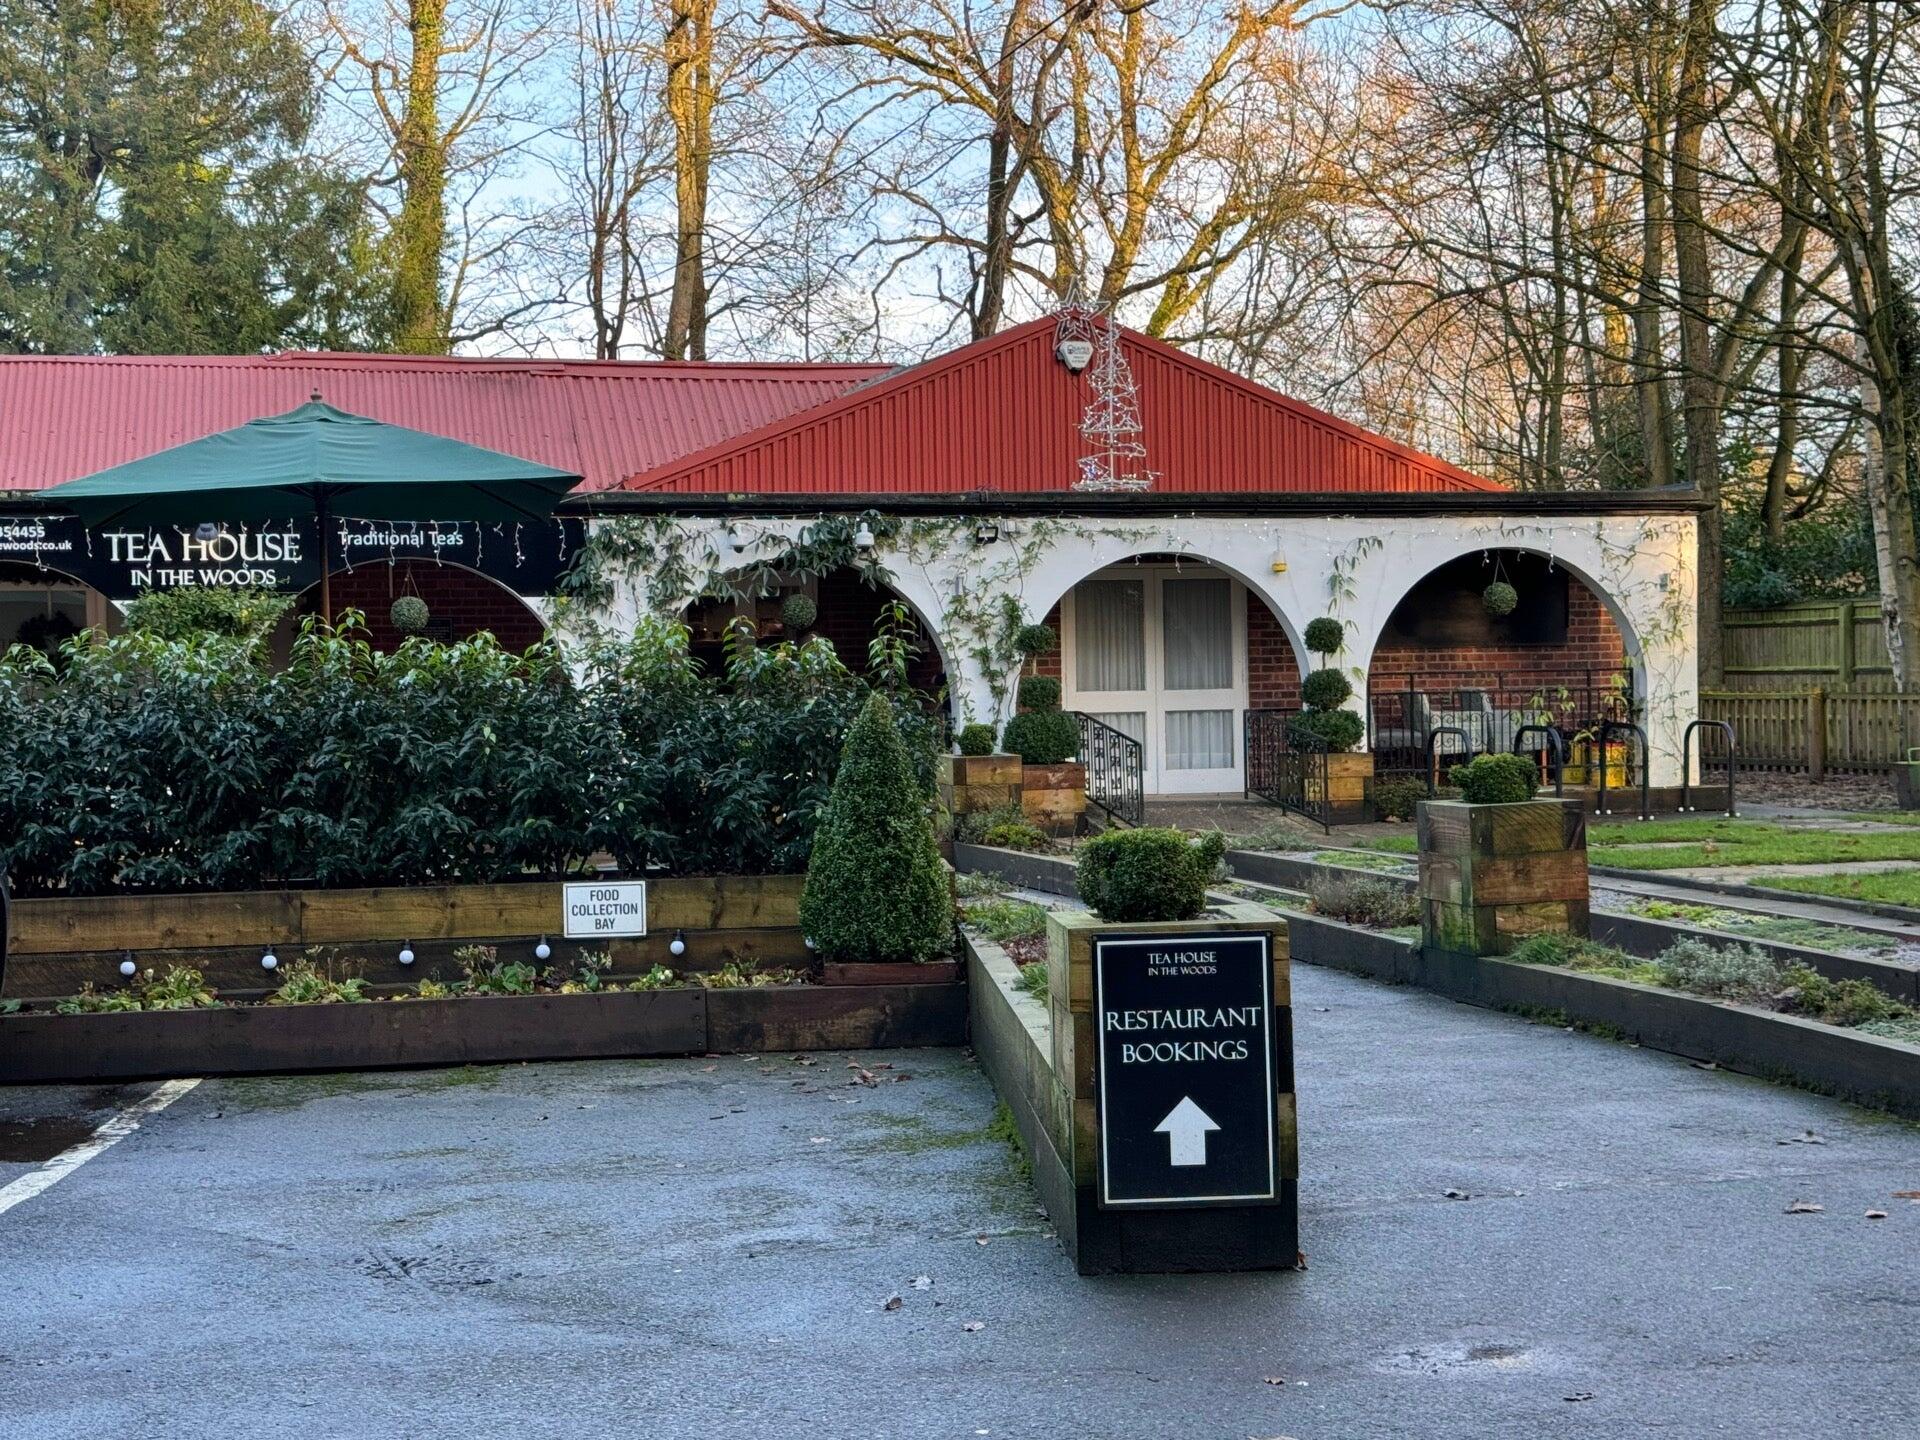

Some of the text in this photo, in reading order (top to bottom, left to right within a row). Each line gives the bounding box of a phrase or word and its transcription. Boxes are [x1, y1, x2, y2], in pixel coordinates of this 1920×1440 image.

[337, 530, 464, 546] Traditional Teas
[102, 533, 302, 562] TEA HOUSE
[131, 569, 276, 586] IN THE WOODS
[589, 889, 620, 902] FOOD
[571, 903, 638, 917] COLLECTION
[594, 918, 616, 930] BAY
[1147, 951, 1217, 964] TEA HOUSE
[1148, 965, 1217, 976] IN THE WOODS
[1106, 1006, 1262, 1031] RESTAURANT
[1122, 1040, 1248, 1063] BOOKINGS
